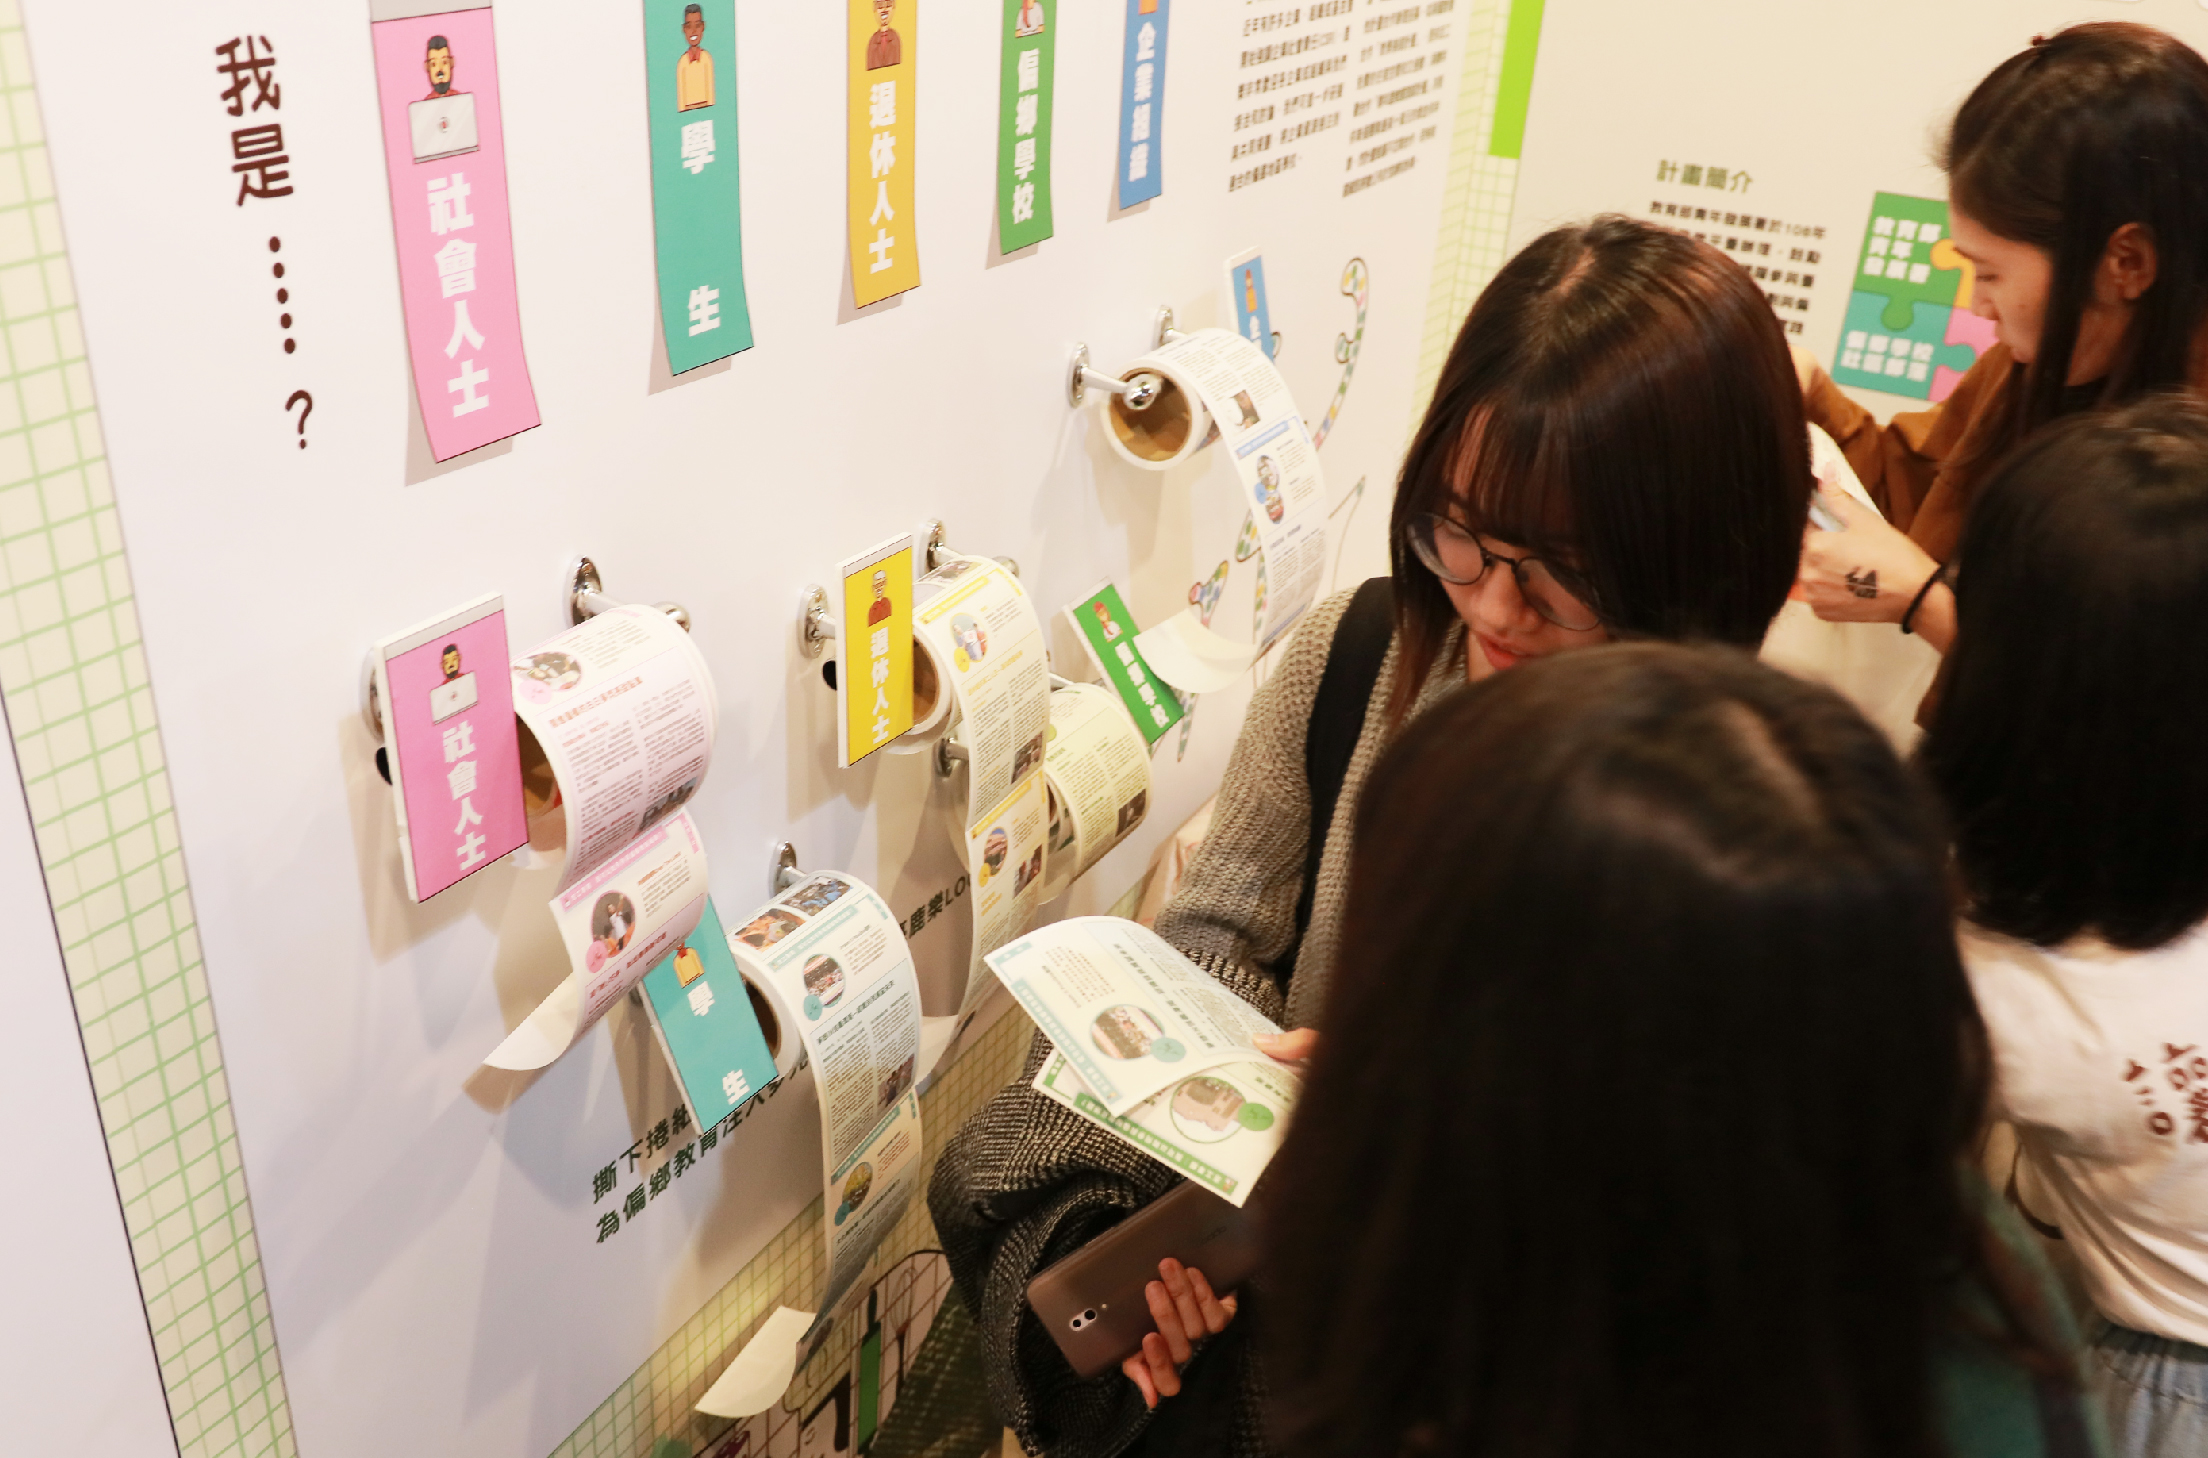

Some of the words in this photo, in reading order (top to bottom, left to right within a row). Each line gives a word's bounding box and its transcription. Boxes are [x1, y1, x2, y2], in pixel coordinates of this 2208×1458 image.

[680, 119, 721, 337] 學生
[868, 80, 897, 274] 退休人士
[426, 172, 489, 418] 社會人士
[870, 626, 890, 745] 退休人士
[443, 719, 486, 871] 社會人士
[687, 980, 750, 1105] 學生
